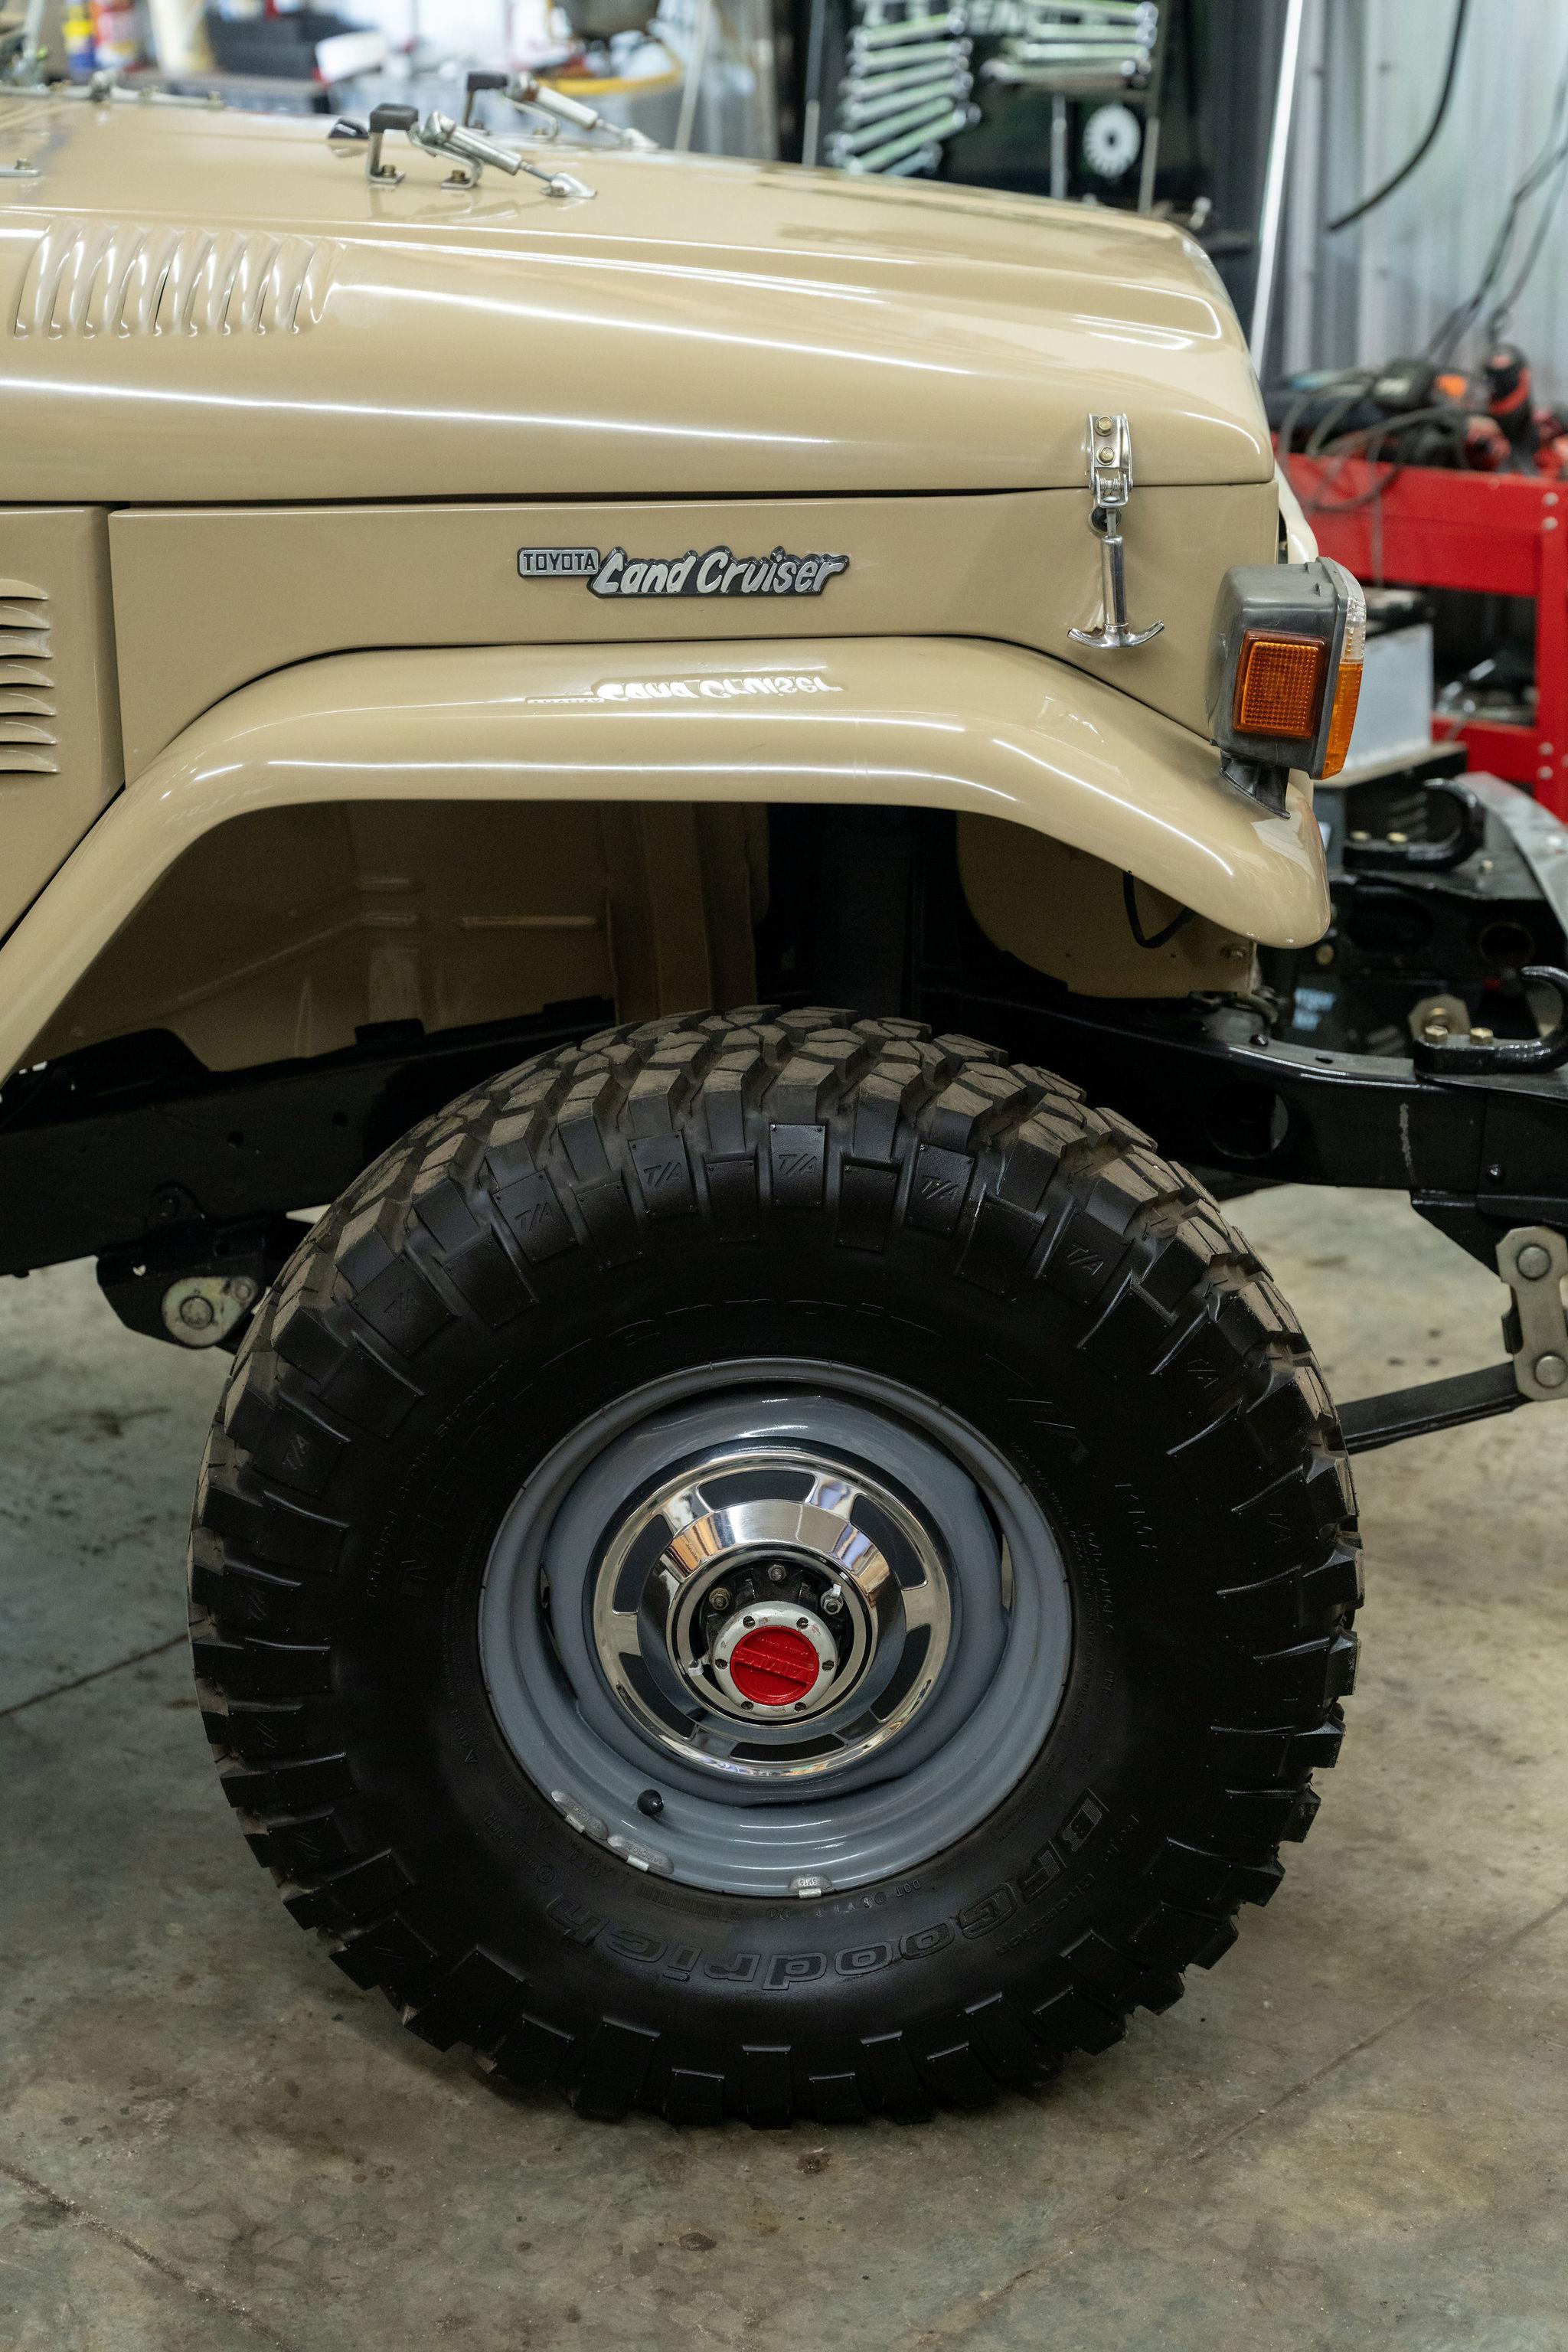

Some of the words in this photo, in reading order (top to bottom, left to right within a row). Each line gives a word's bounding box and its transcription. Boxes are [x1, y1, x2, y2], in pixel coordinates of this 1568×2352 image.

[522, 552, 597, 573] TOYOTA
[592, 549, 698, 595] Land
[696, 549, 846, 595] Cruiser
[643, 1161, 684, 1188] T/A
[777, 1152, 817, 1176] T/A
[921, 1174, 960, 1200] T/A
[514, 1200, 554, 1233] T/A
[546, 1785, 1111, 1991] BFGoodrich
